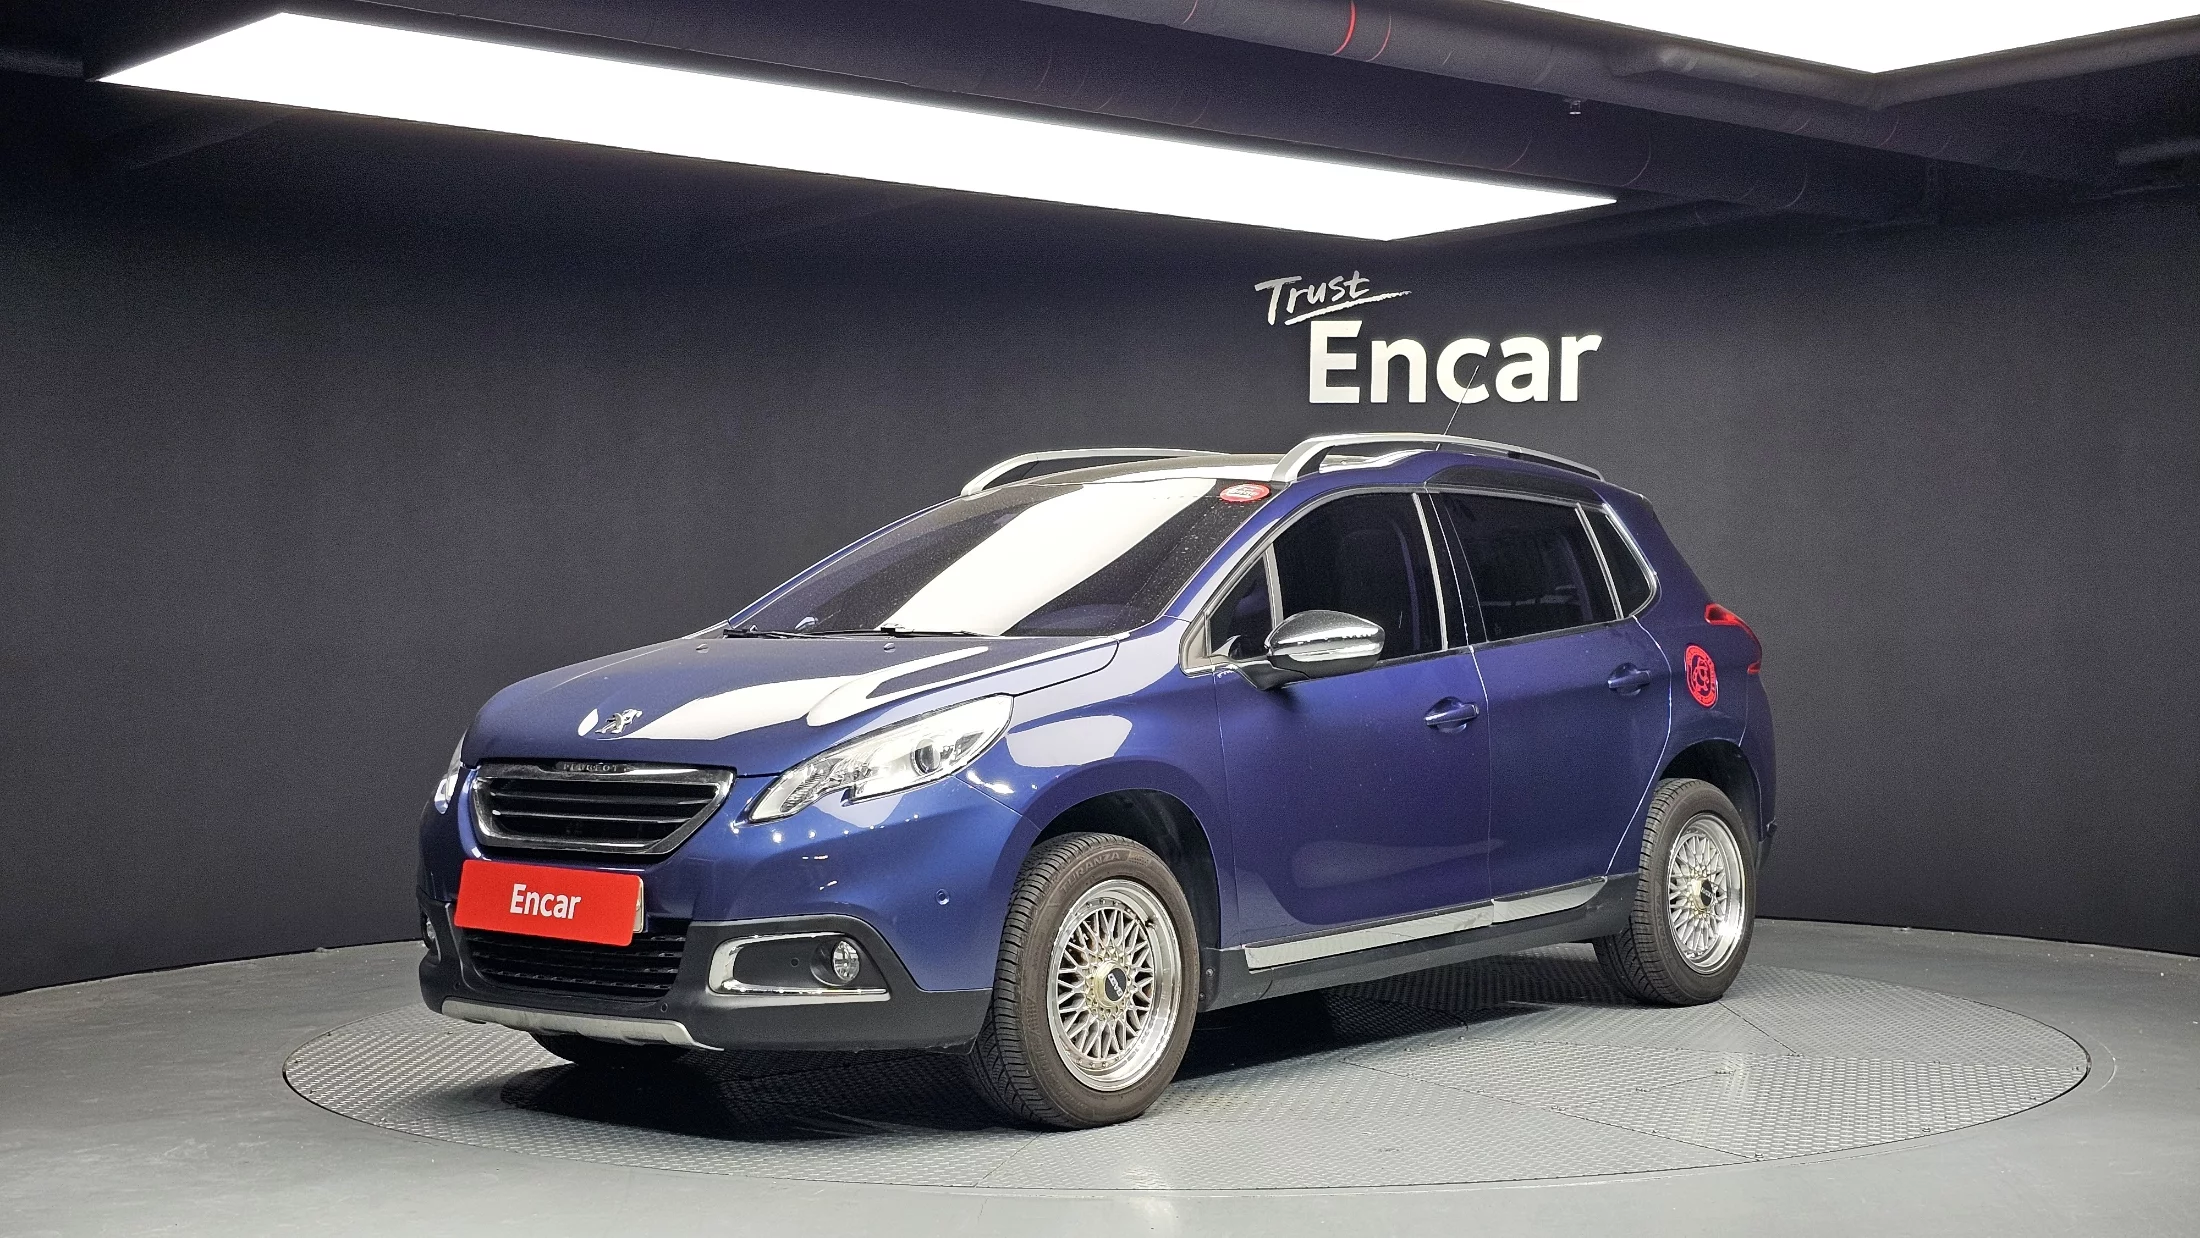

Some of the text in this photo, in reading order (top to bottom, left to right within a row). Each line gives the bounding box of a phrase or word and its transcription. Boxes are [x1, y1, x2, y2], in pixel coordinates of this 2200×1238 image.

[1254, 270, 1372, 326] Trust
[1308, 319, 1603, 404] Encar
[1060, 851, 1120, 894] TURANZA
[509, 882, 582, 920] Encar
